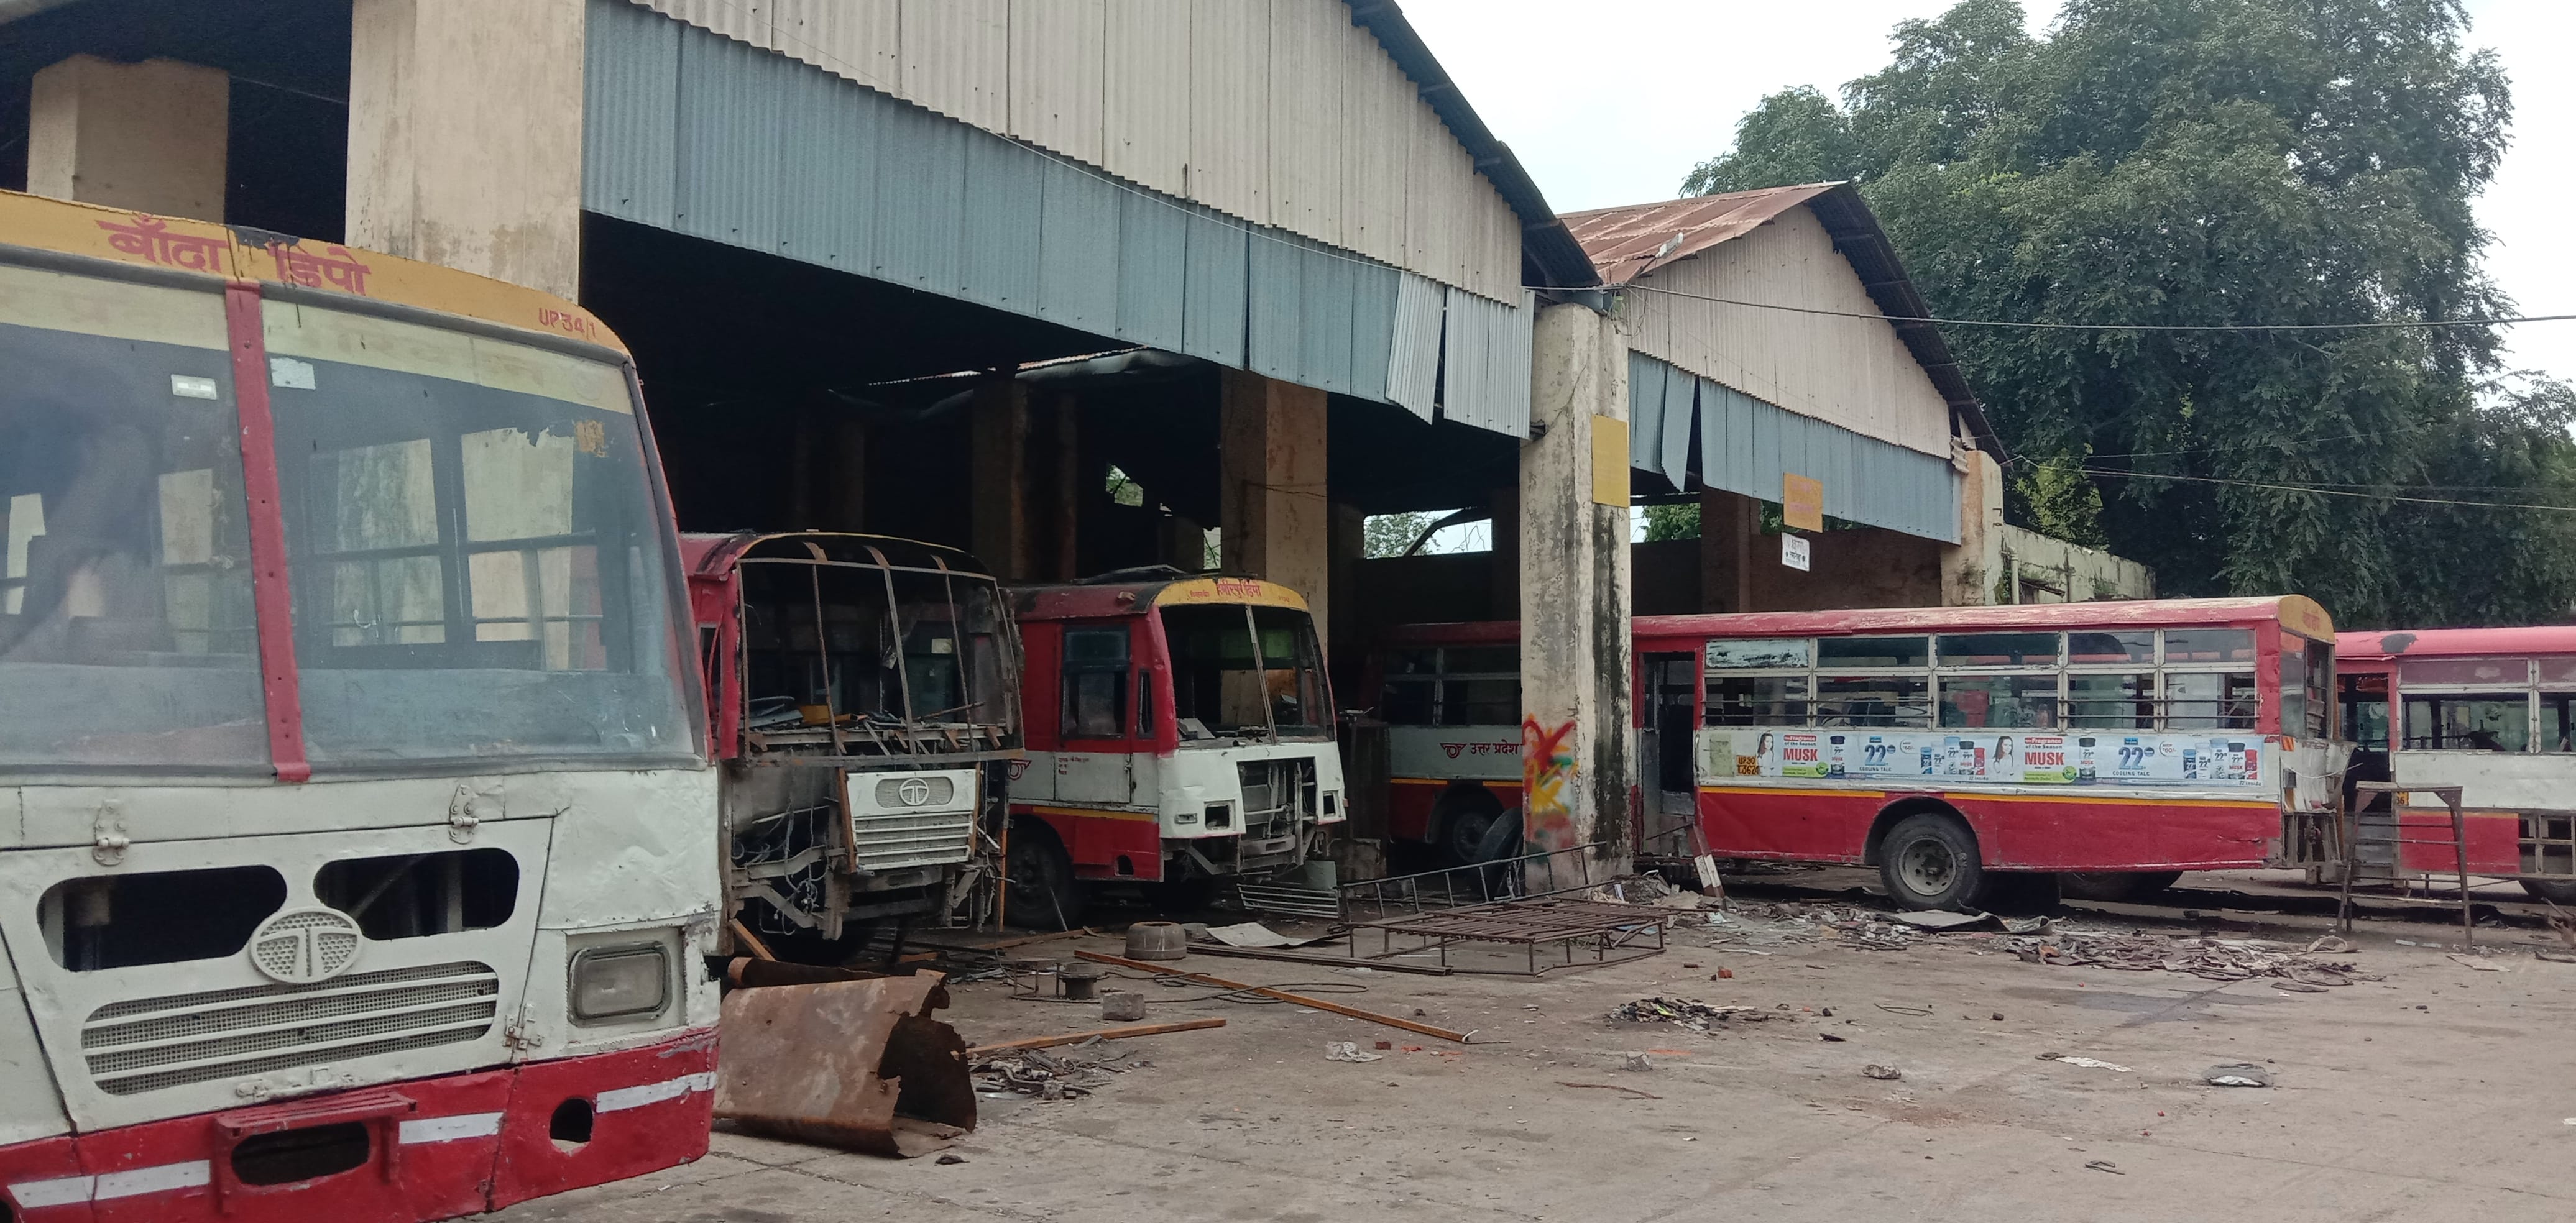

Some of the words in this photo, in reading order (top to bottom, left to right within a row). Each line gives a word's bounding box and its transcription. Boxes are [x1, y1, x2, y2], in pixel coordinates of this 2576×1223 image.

[96, 214, 229, 273] बाँदा
[1470, 743, 1491, 756] उत्तर
[1493, 739, 1519, 755] प्रदेश
[1783, 748, 1818, 761] MUSK
[1865, 745, 1886, 766] 22
[2025, 751, 2064, 766] MUSK
[2118, 747, 2144, 770] 22
